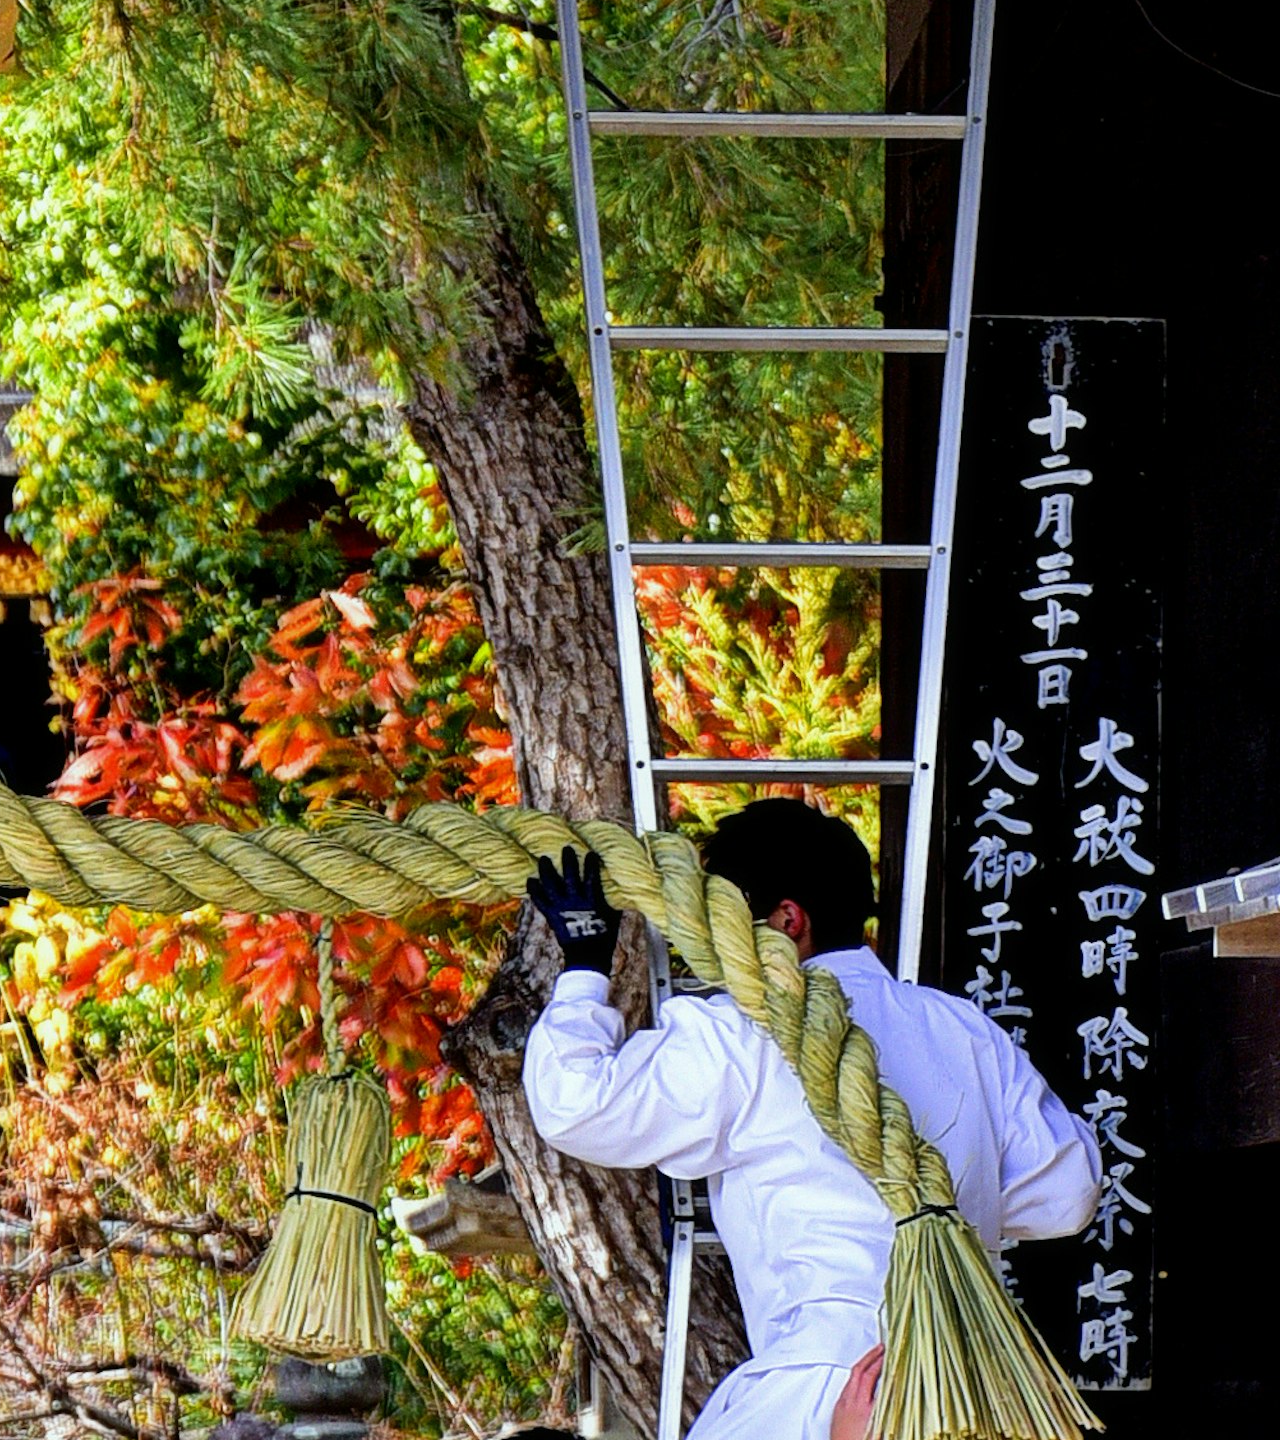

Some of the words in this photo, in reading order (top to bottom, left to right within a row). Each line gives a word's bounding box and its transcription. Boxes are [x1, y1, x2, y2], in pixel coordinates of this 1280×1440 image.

[1020, 394, 1094, 710] 十二月三十一日
